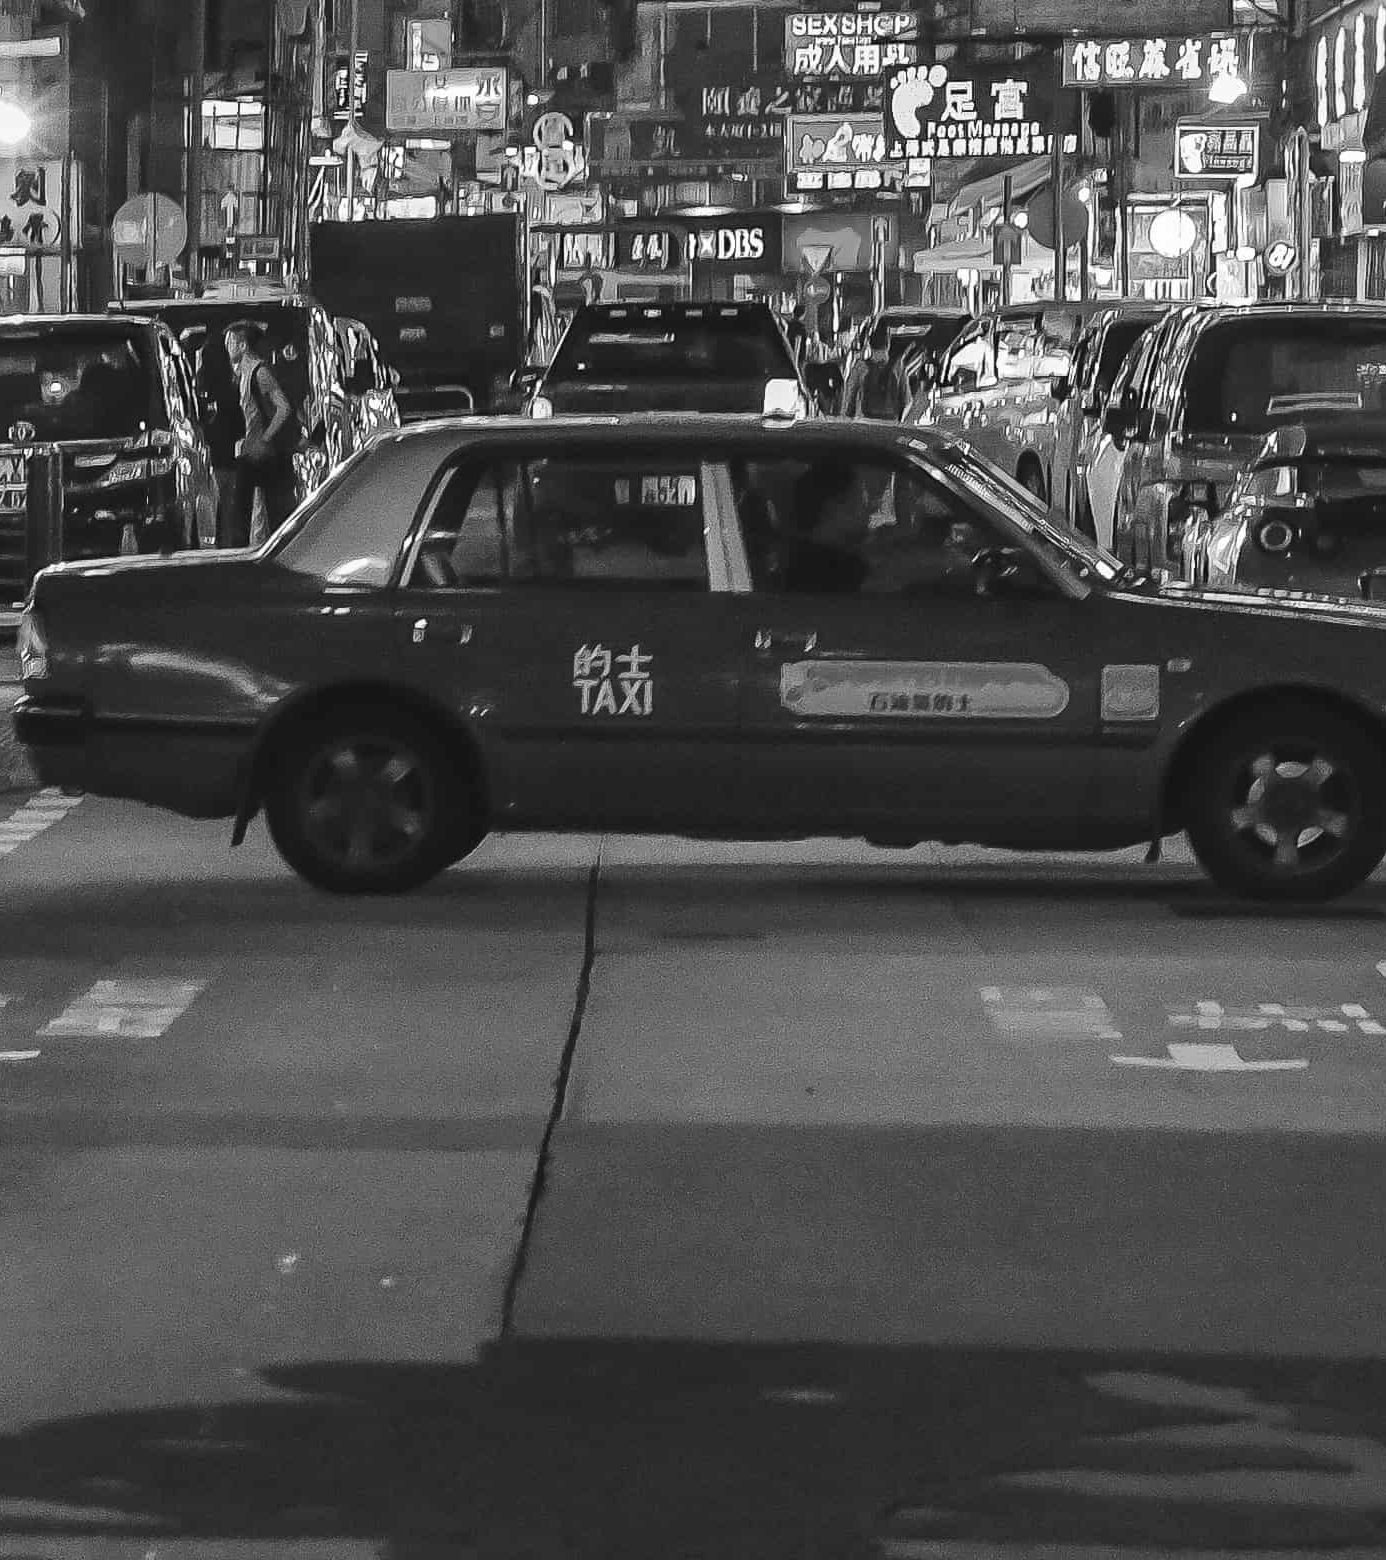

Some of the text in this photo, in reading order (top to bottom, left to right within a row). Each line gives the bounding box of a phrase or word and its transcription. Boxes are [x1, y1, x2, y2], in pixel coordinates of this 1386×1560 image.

[792, 13, 910, 37] SEX SHOP
[716, 228, 764, 260] DBS
[573, 642, 654, 679] 的士
[573, 678, 654, 717] TAXI
